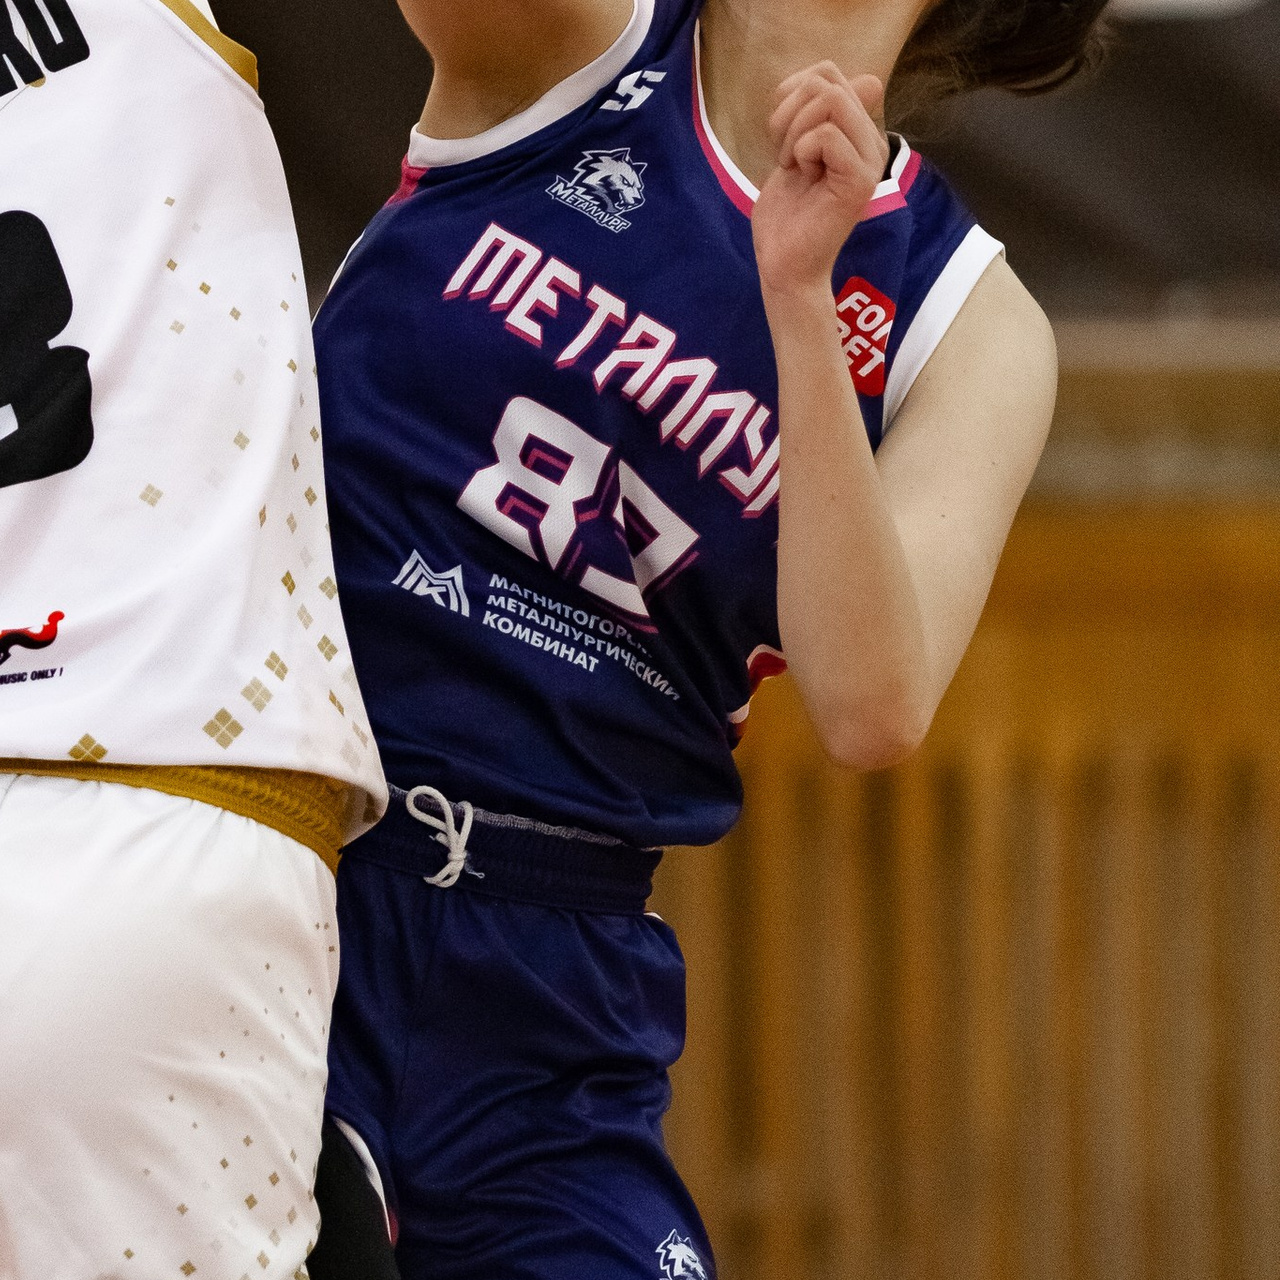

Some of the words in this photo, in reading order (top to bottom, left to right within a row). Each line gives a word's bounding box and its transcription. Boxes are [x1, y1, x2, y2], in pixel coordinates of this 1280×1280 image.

[442, 222, 779, 518] МЕТАЛЛУ
[482, 610, 600, 672] КОМБИНАТ
[30, 668, 57, 681] ONLY
